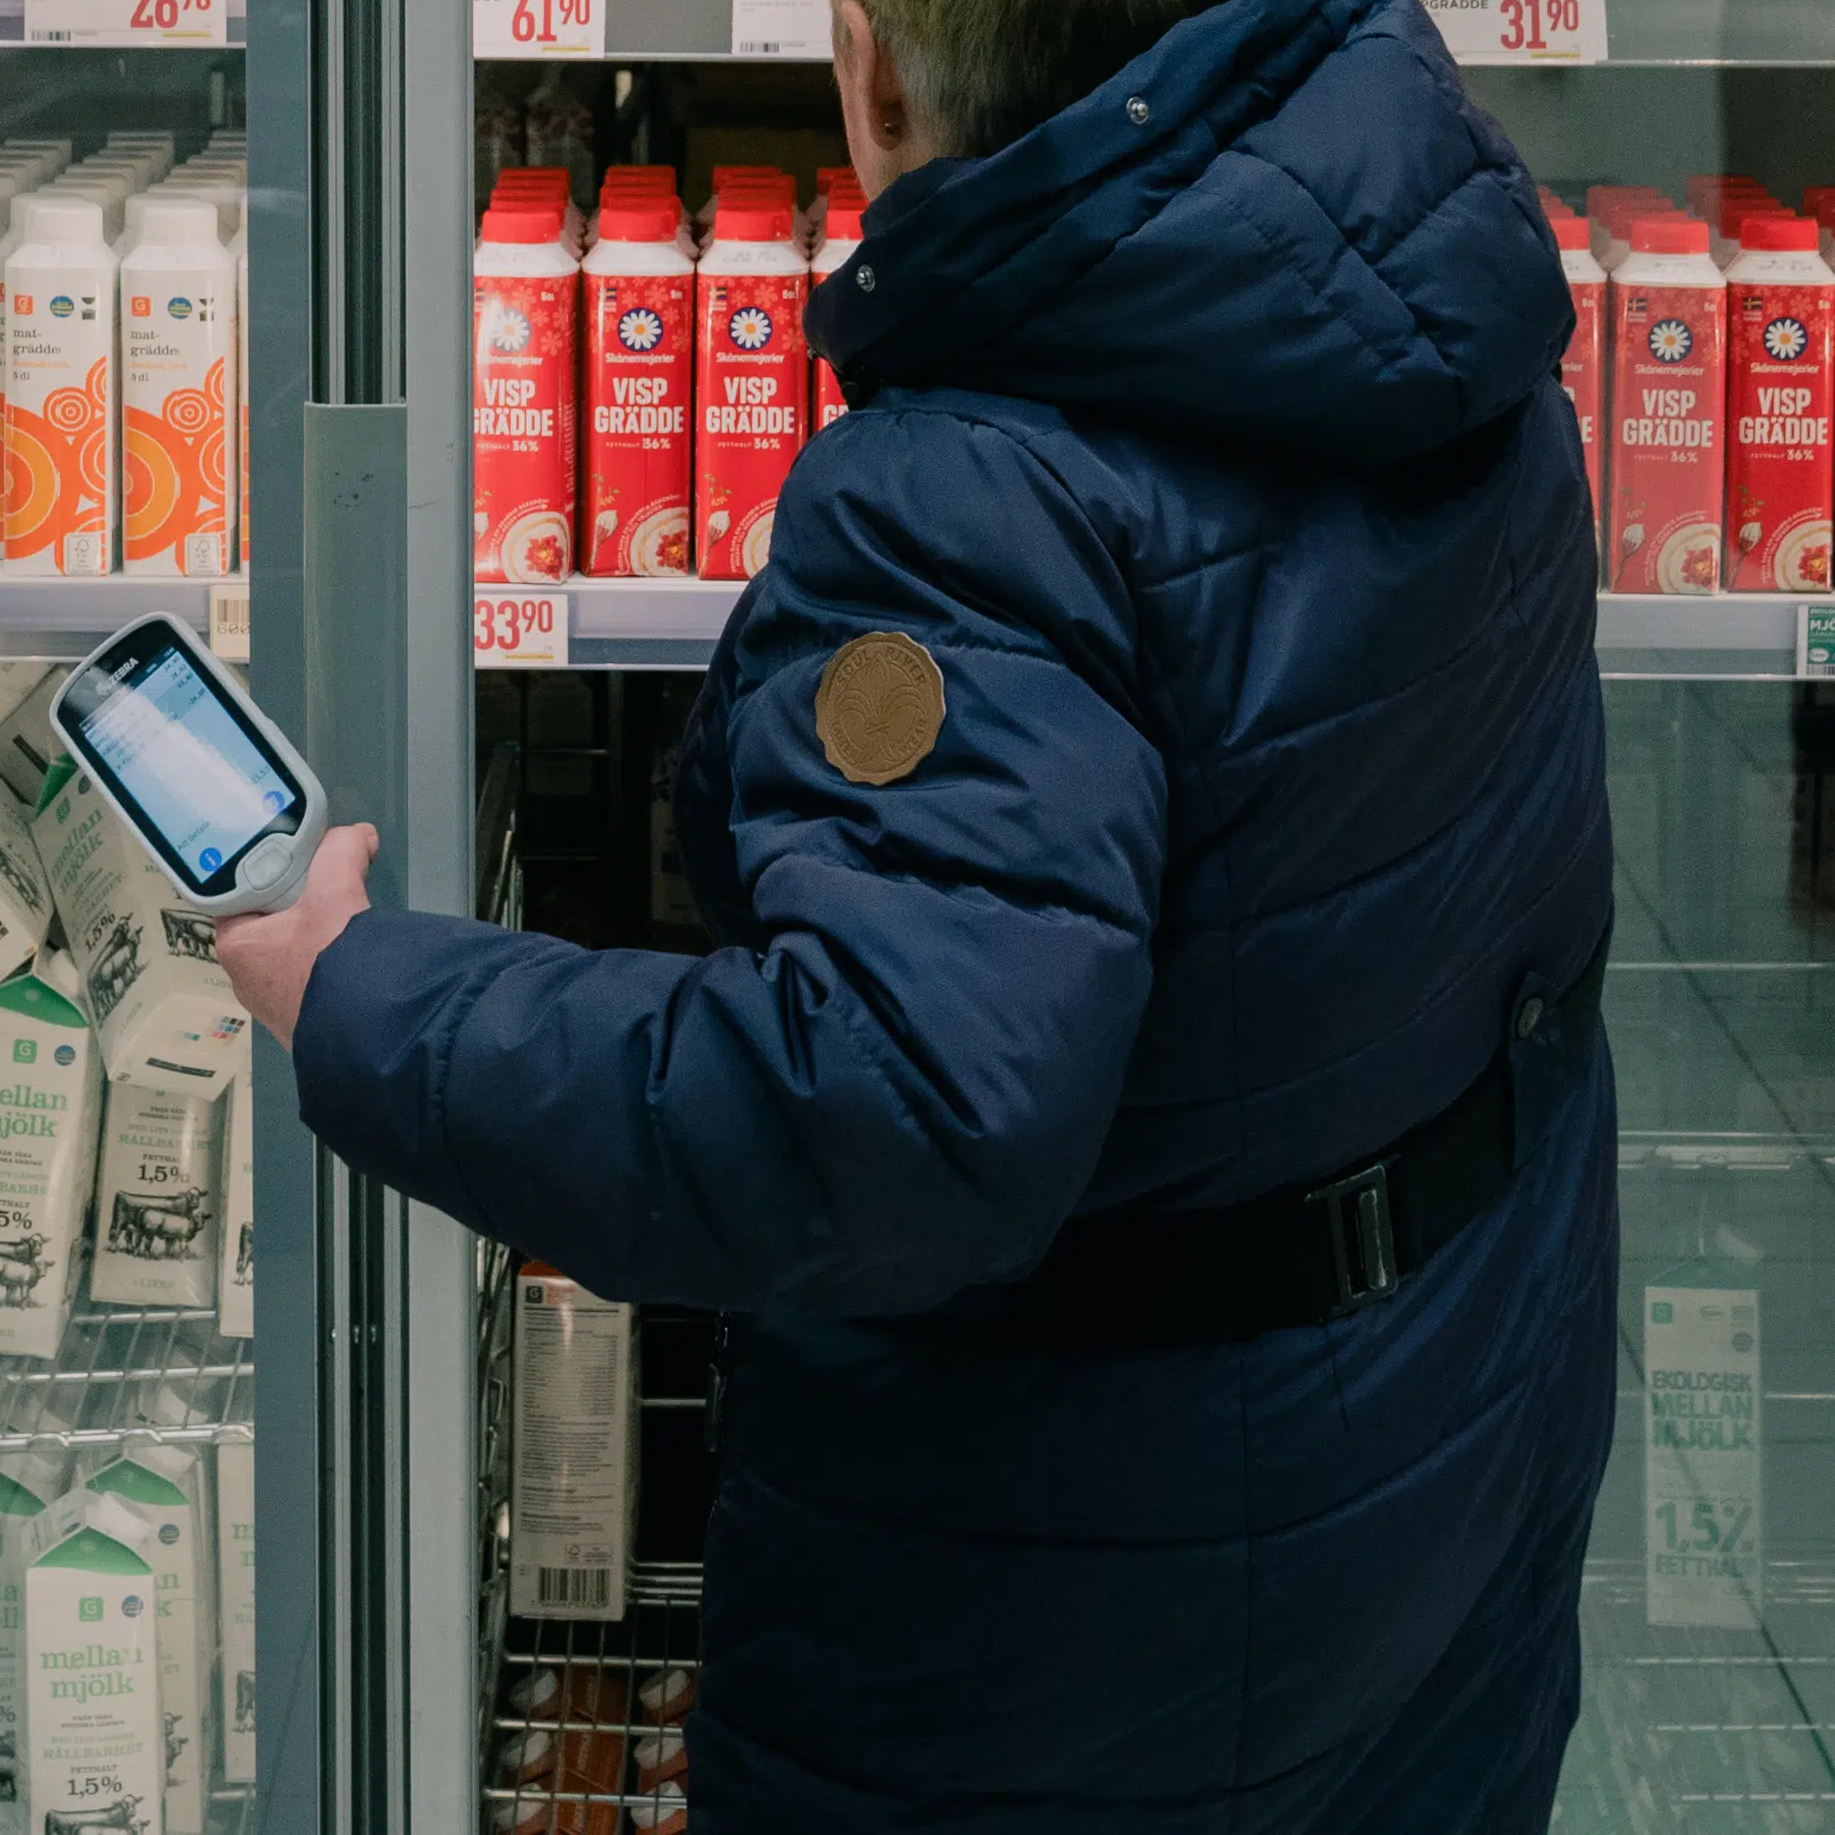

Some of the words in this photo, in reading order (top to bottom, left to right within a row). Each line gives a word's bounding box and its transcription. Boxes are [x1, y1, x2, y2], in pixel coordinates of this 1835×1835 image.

[612, 378, 668, 404] VISP
[723, 377, 776, 404] VISP
[1757, 387, 1812, 416] VISP
[595, 405, 684, 434] GRÄDDE
[706, 405, 795, 434] GRÄDDE
[1738, 416, 1828, 446] GRÄDDE
[643, 438, 671, 449] 36%
[475, 600, 553, 650] 3390
[109, 657, 138, 685] ZEBRA
